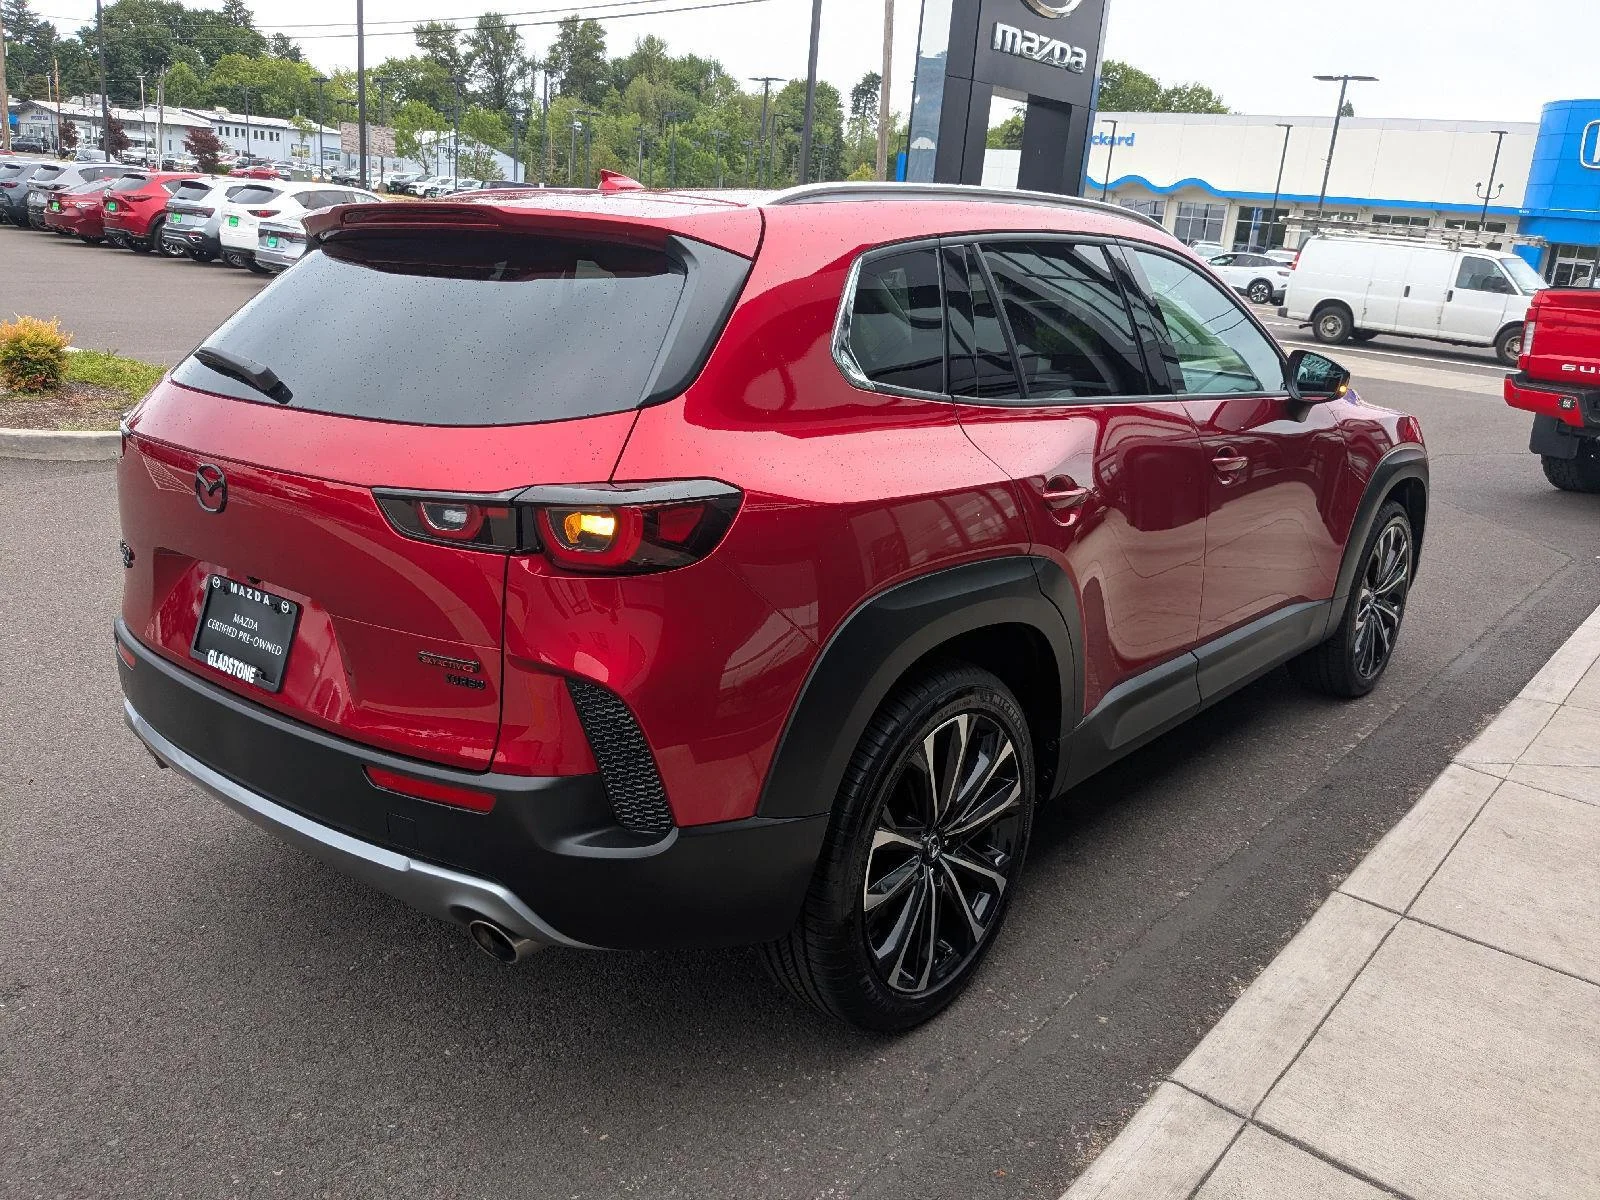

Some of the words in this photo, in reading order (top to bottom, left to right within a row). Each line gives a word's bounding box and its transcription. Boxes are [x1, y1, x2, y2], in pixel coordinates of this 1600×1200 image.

[1561, 363, 1600, 374] SU
[230, 582, 270, 606] MAZDA
[232, 613, 258, 632] MAZDA
[207, 618, 238, 638] CERTIFIED
[238, 630, 282, 656] PRE-OWNED
[207, 649, 256, 684] GLADSTONE
